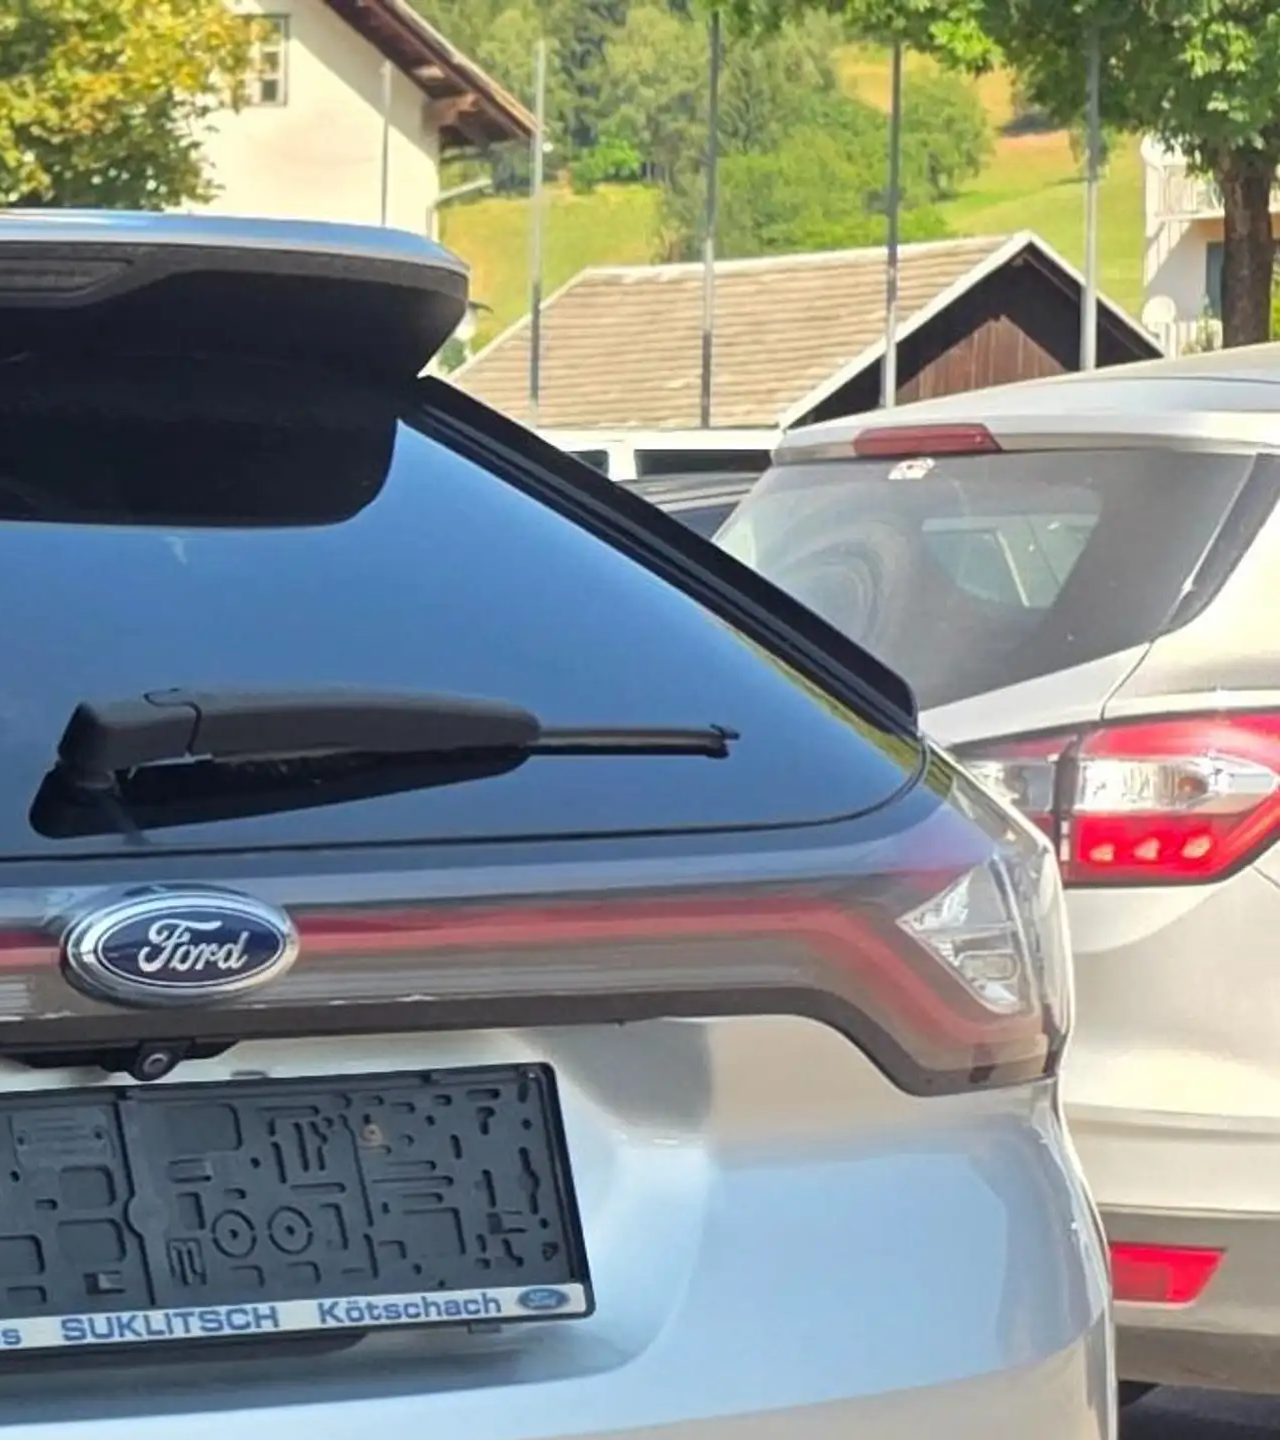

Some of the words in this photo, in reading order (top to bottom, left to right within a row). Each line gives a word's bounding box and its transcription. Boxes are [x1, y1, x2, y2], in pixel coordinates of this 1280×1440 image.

[138, 918, 250, 973] Ford
[60, 1306, 280, 1343] SUKLITSCH
[318, 1292, 502, 1325] Kötschach
